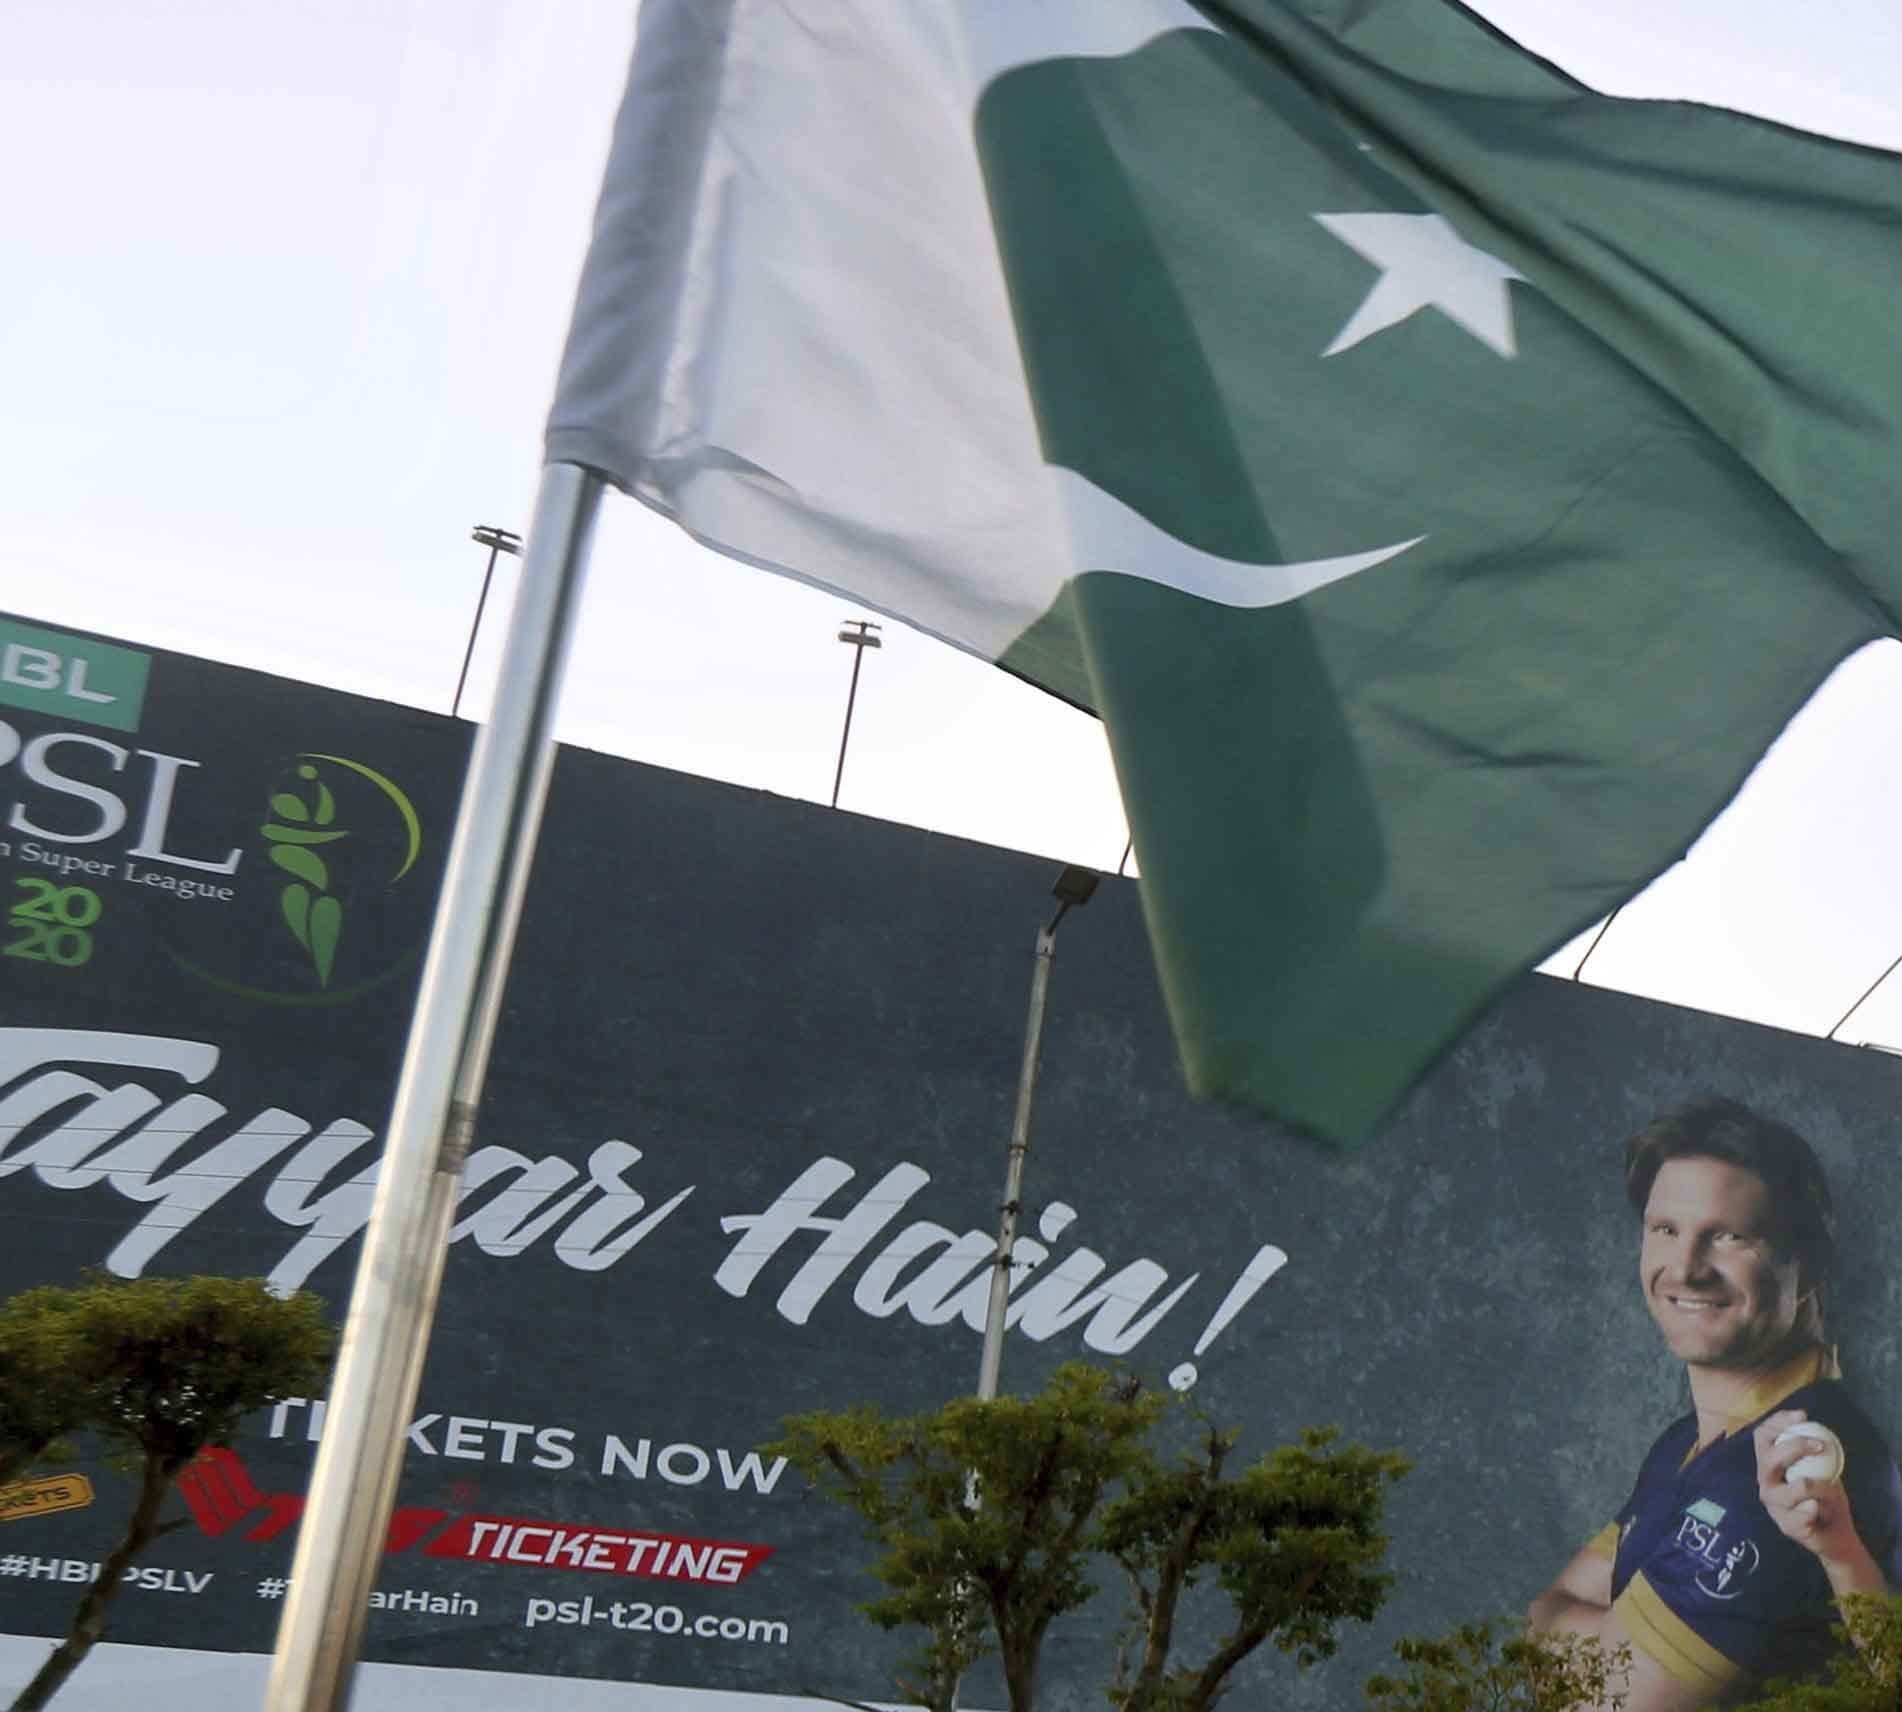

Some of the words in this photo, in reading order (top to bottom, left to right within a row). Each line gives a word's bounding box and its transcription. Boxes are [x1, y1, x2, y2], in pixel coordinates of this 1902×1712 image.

[0, 643, 118, 704] BL
[20, 840, 117, 879] Super
[124, 862, 236, 901] League
[10, 876, 102, 928] 20
[5, 917, 95, 966] 20
[264, 1395, 577, 1471] TIKETS
[600, 1433, 788, 1496] NOW
[468, 1520, 748, 1585] TICKETING
[525, 1594, 790, 1646] psl-t20.com
